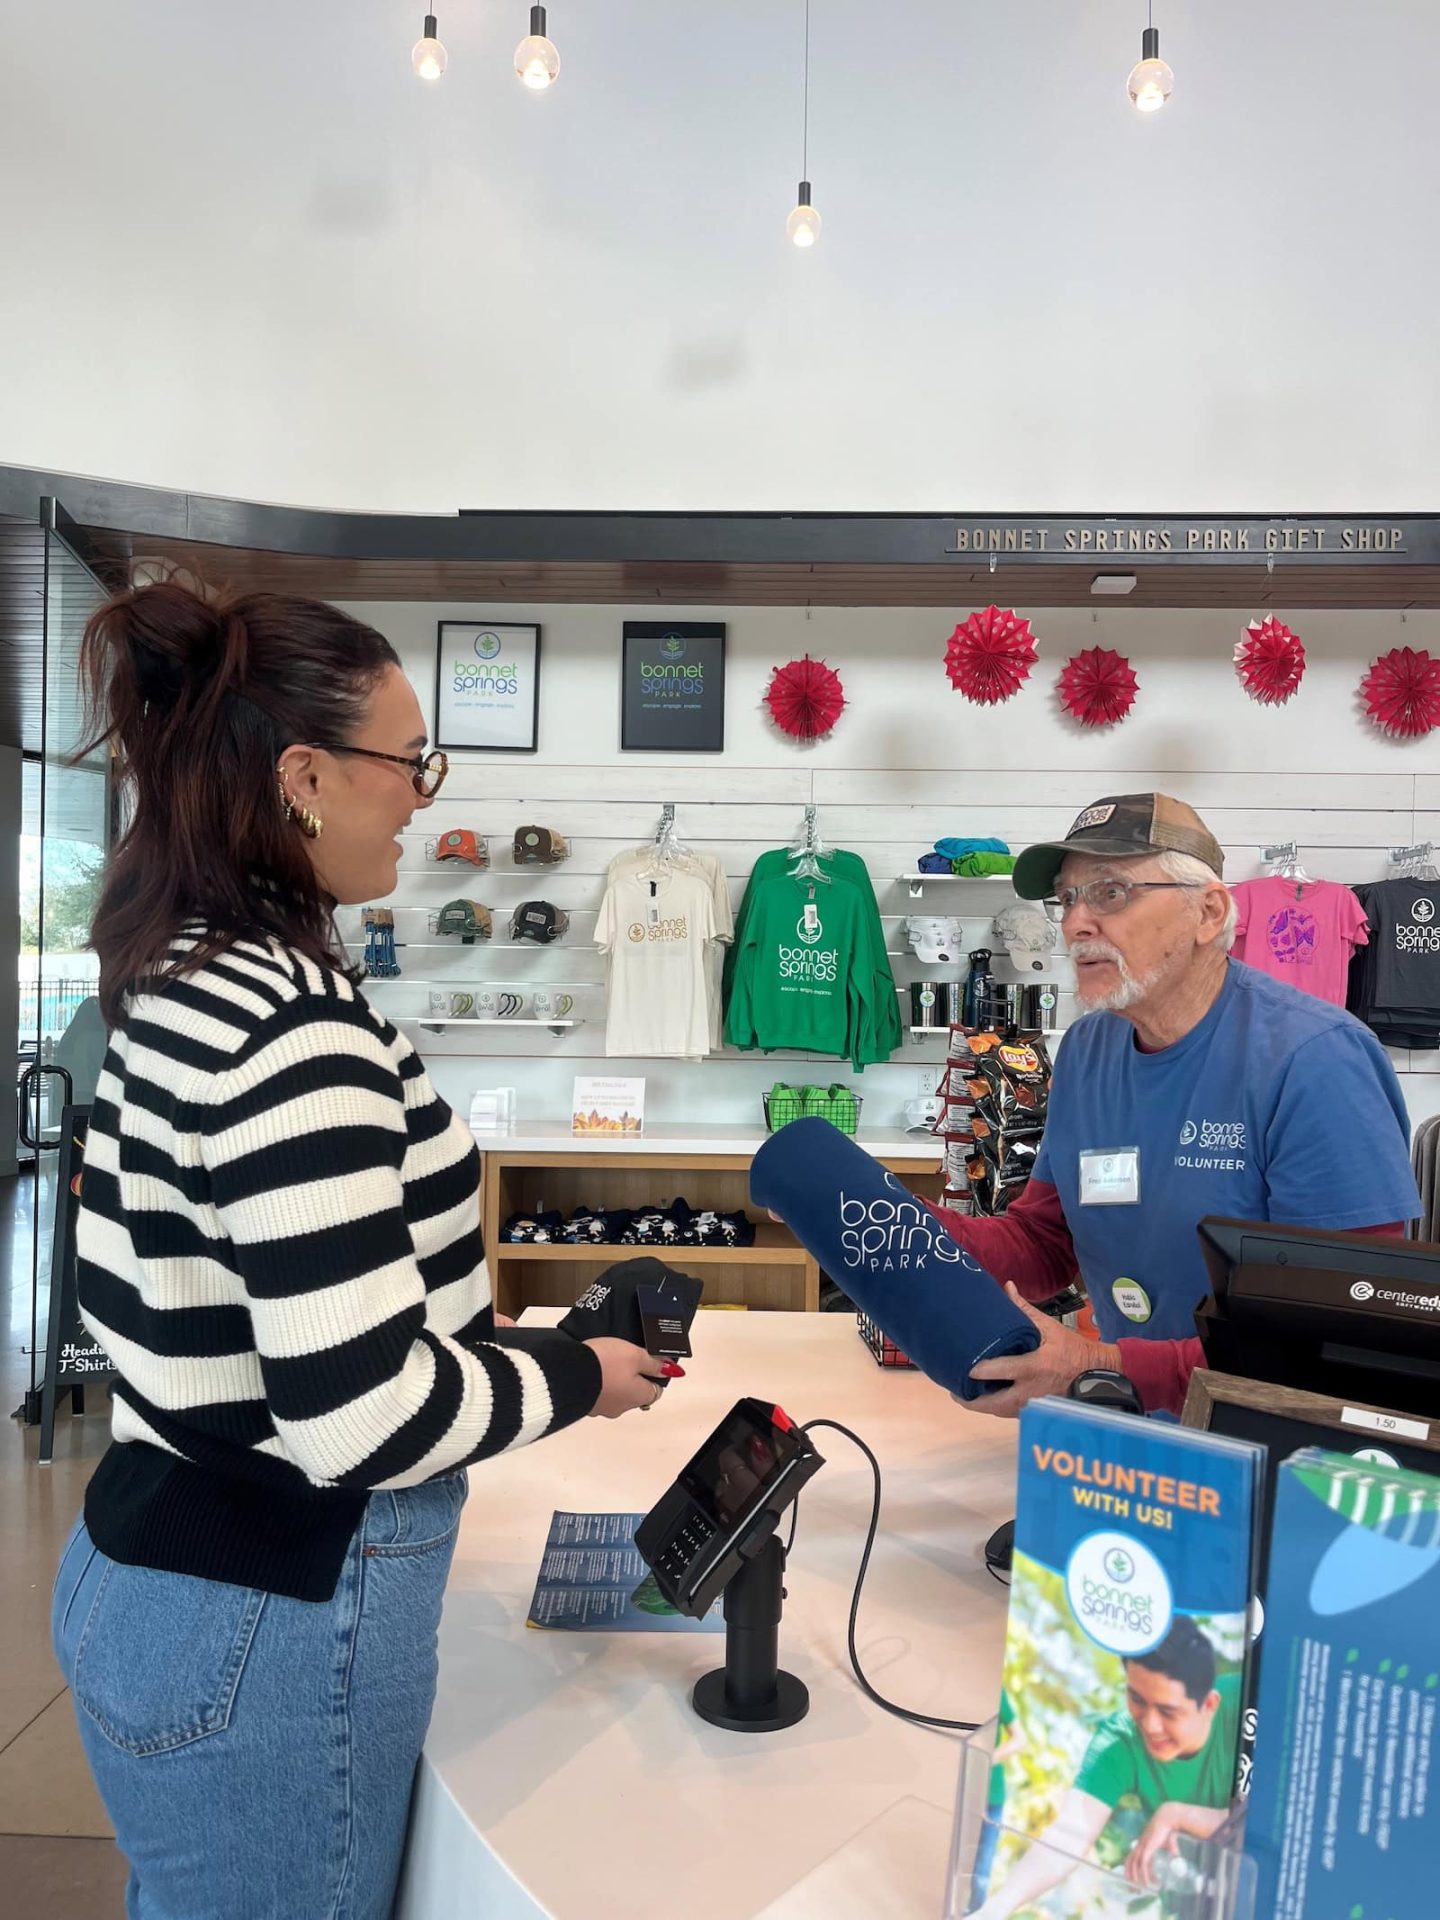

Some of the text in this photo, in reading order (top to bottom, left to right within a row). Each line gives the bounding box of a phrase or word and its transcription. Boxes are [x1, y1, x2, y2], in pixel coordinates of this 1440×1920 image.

[955, 528, 1403, 551] BONNET SPRINGS PARK GIFT SHOP
[454, 660, 518, 678] bonnet
[641, 662, 704, 678] bonnet
[453, 677, 518, 694] springs
[641, 678, 704, 694] springs
[648, 927, 688, 941] springs
[1396, 923, 1440, 938] bonne
[1396, 936, 1440, 951] spring
[779, 944, 839, 965] bonnet
[779, 961, 837, 982] springs
[1202, 1119, 1245, 1134] bonne
[840, 1191, 947, 1234] bonn
[870, 1253, 928, 1273] PARK
[1376, 1288, 1440, 1312] centered
[1376, 1416, 1397, 1430] 1.50
[1032, 1444, 1221, 1517] VOLUNTEER
[1072, 1485, 1174, 1530] WITH US!
[1082, 1574, 1153, 1614] bonnet
[1081, 1595, 1153, 1636] springs
